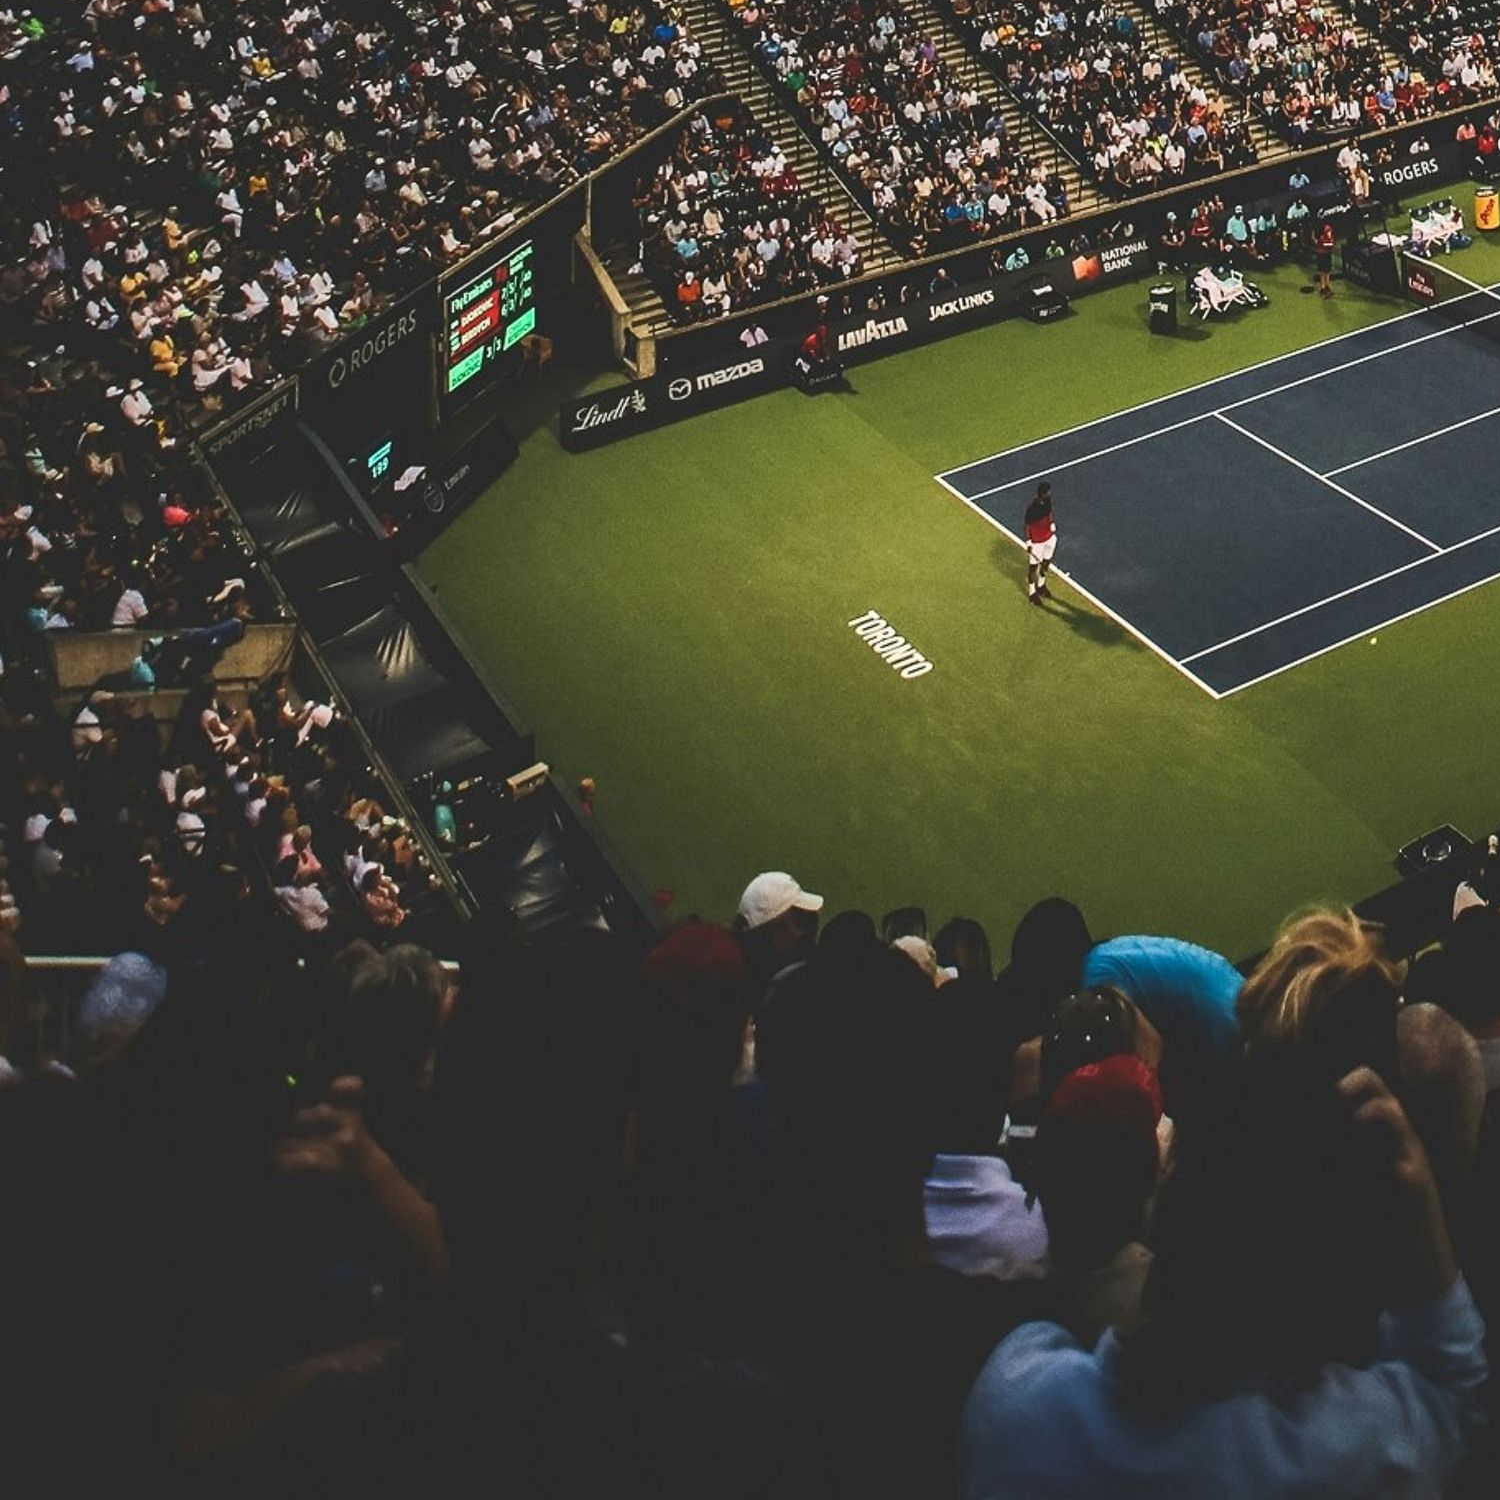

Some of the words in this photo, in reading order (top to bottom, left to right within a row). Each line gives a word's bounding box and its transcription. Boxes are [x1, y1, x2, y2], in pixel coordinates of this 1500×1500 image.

[1382, 157, 1439, 186] ROGERS
[1101, 240, 1150, 261] NATIONAL
[1103, 256, 1132, 273] BANK
[929, 302, 959, 322] JACK
[351, 308, 416, 373] ROGERS
[838, 316, 908, 351] LAVAZZA
[571, 397, 630, 432] Lindt
[848, 609, 934, 679] TORONTO
